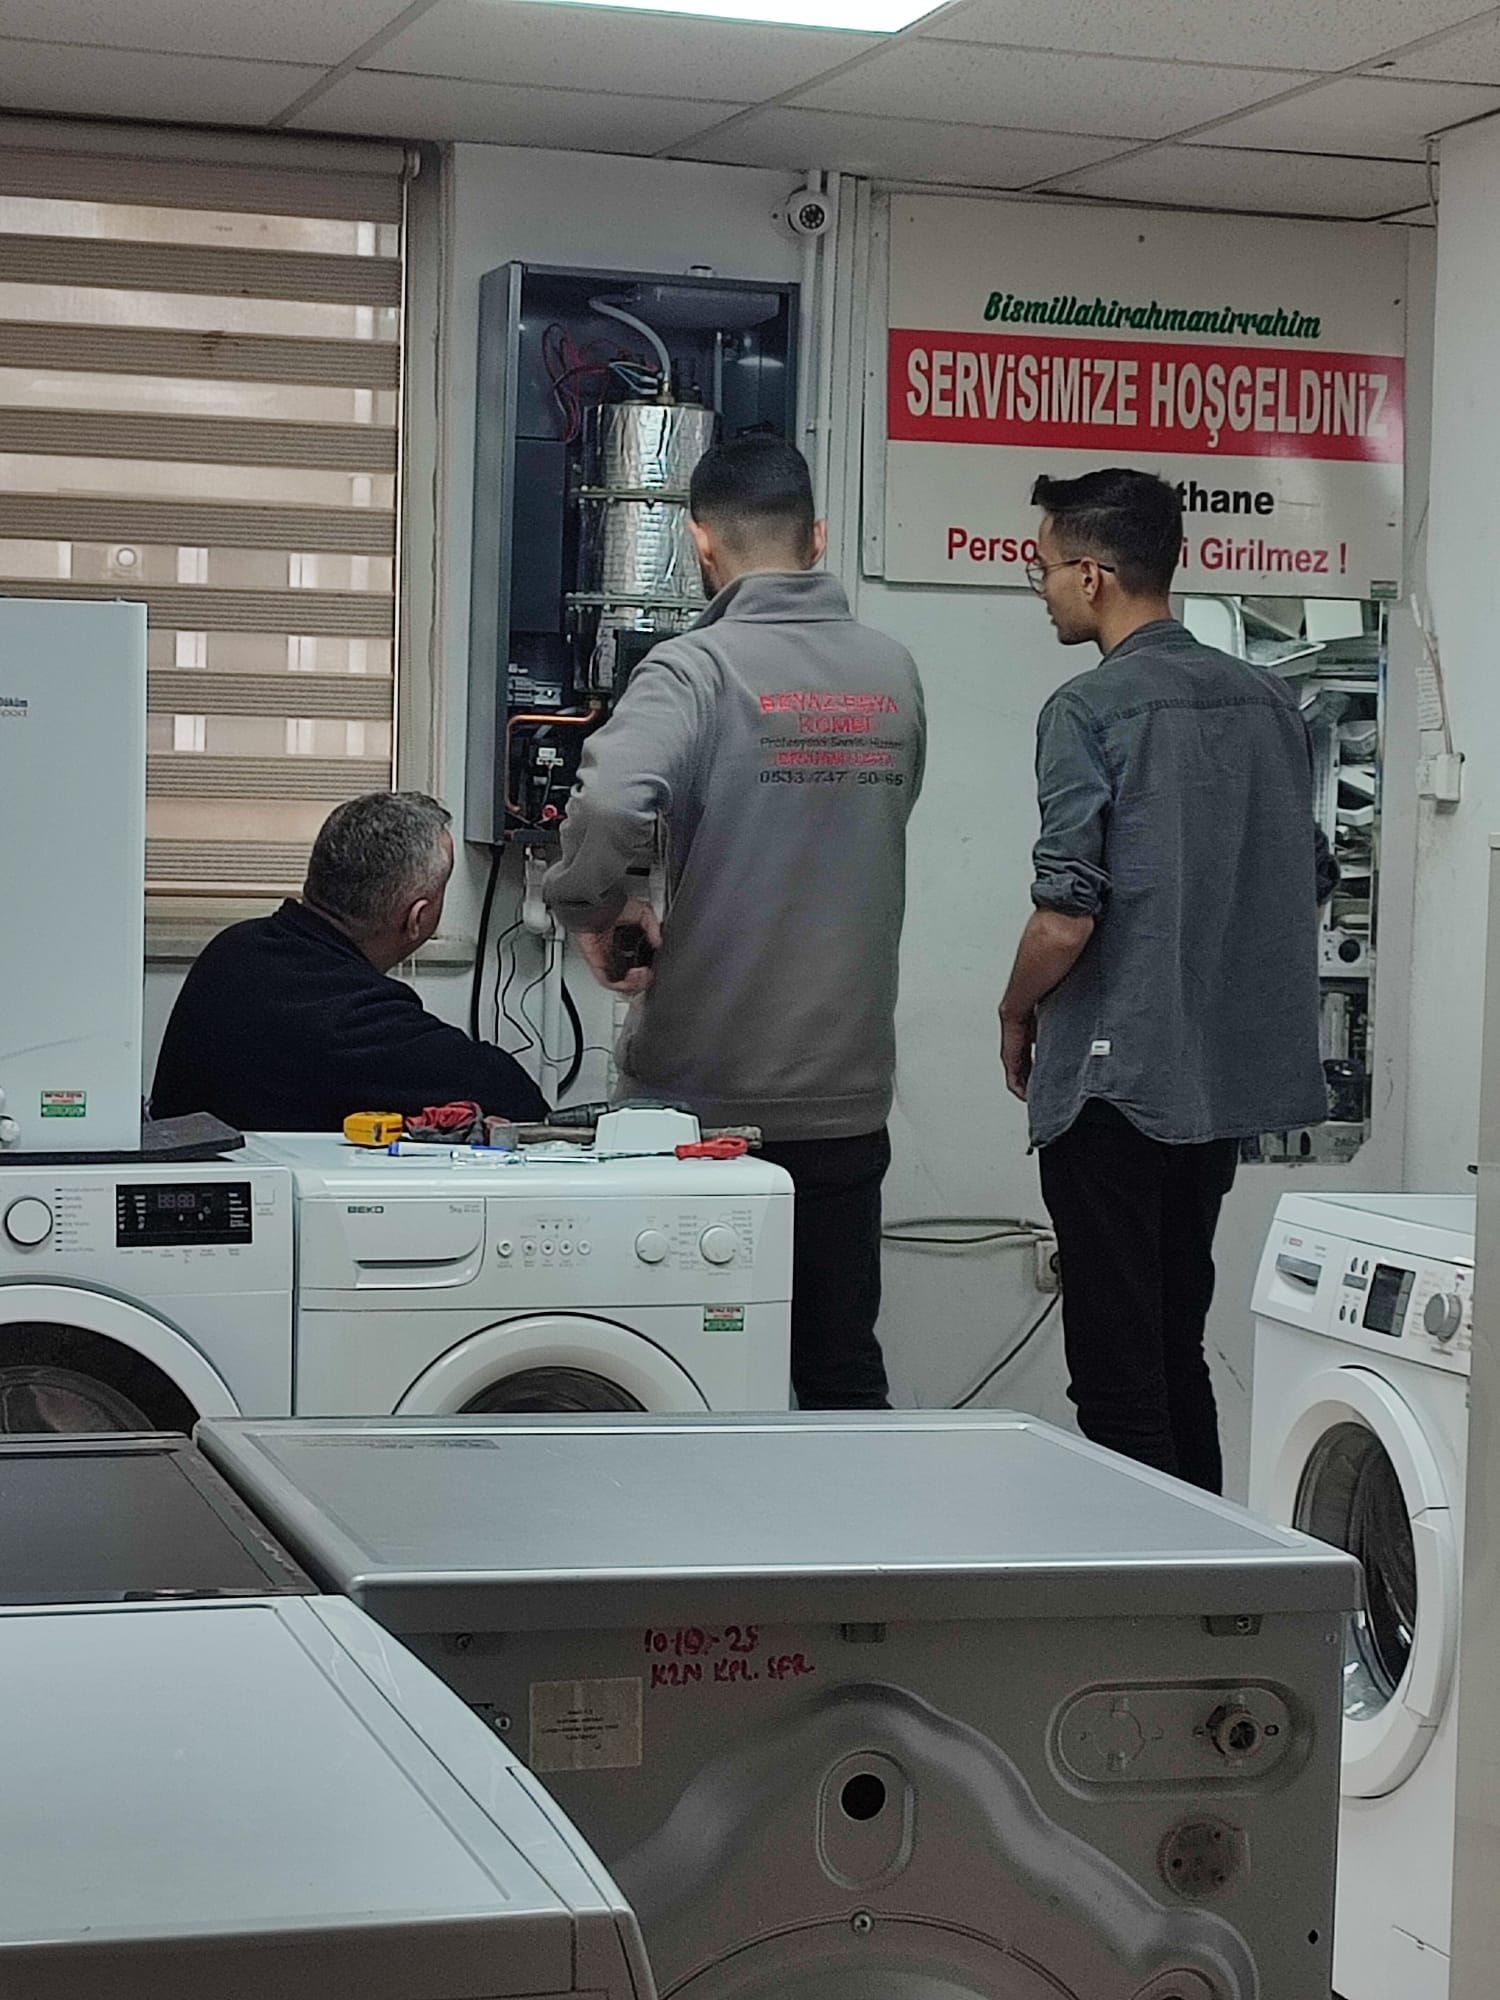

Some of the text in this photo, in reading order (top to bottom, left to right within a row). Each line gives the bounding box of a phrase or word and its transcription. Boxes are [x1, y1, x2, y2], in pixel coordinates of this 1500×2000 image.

[984, 291, 1321, 338] Bismillahirahmanirrahim
[1176, 481, 1275, 515] thane
[947, 527, 1038, 562] Perso
[1200, 537, 1328, 574] Girilmez
